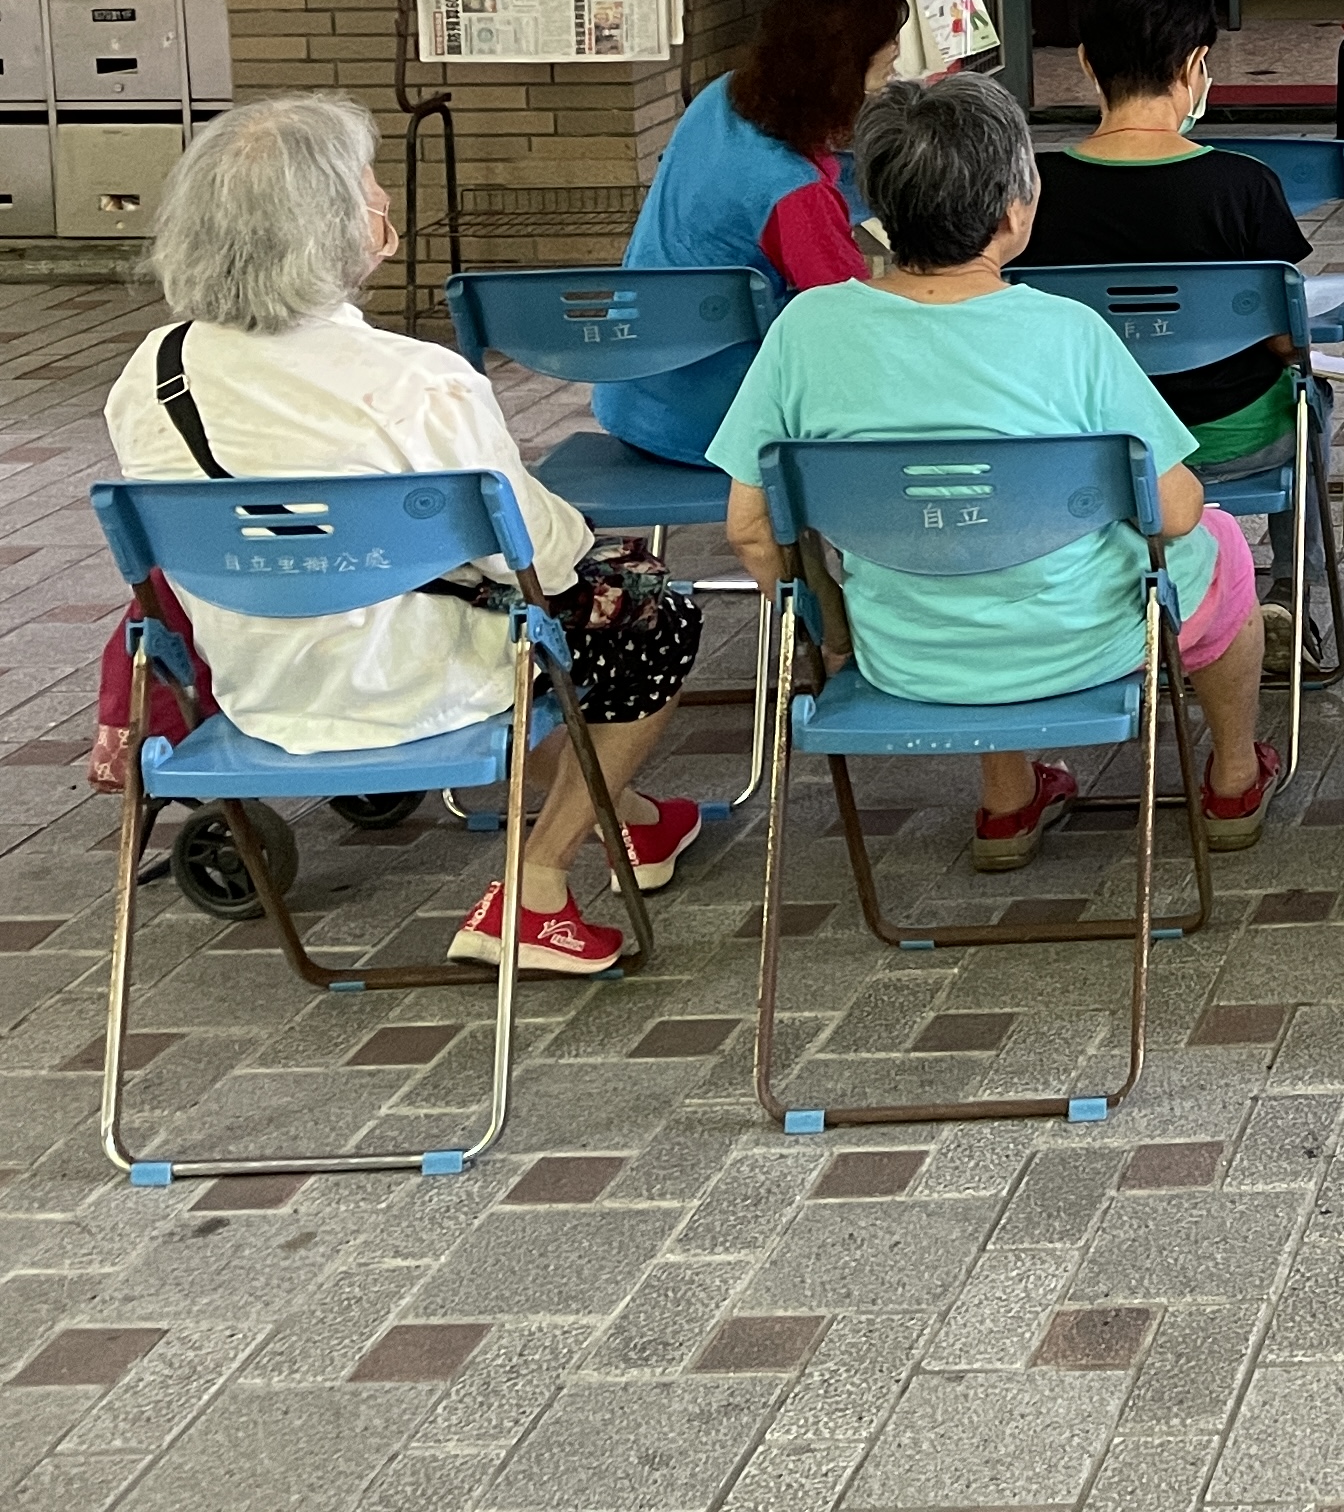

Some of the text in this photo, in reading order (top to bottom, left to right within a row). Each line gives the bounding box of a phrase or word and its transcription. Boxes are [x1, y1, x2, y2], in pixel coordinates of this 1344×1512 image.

[583, 323, 638, 343] 自立
[921, 503, 989, 530] 自立
[223, 546, 393, 575] 自立里辦公處
